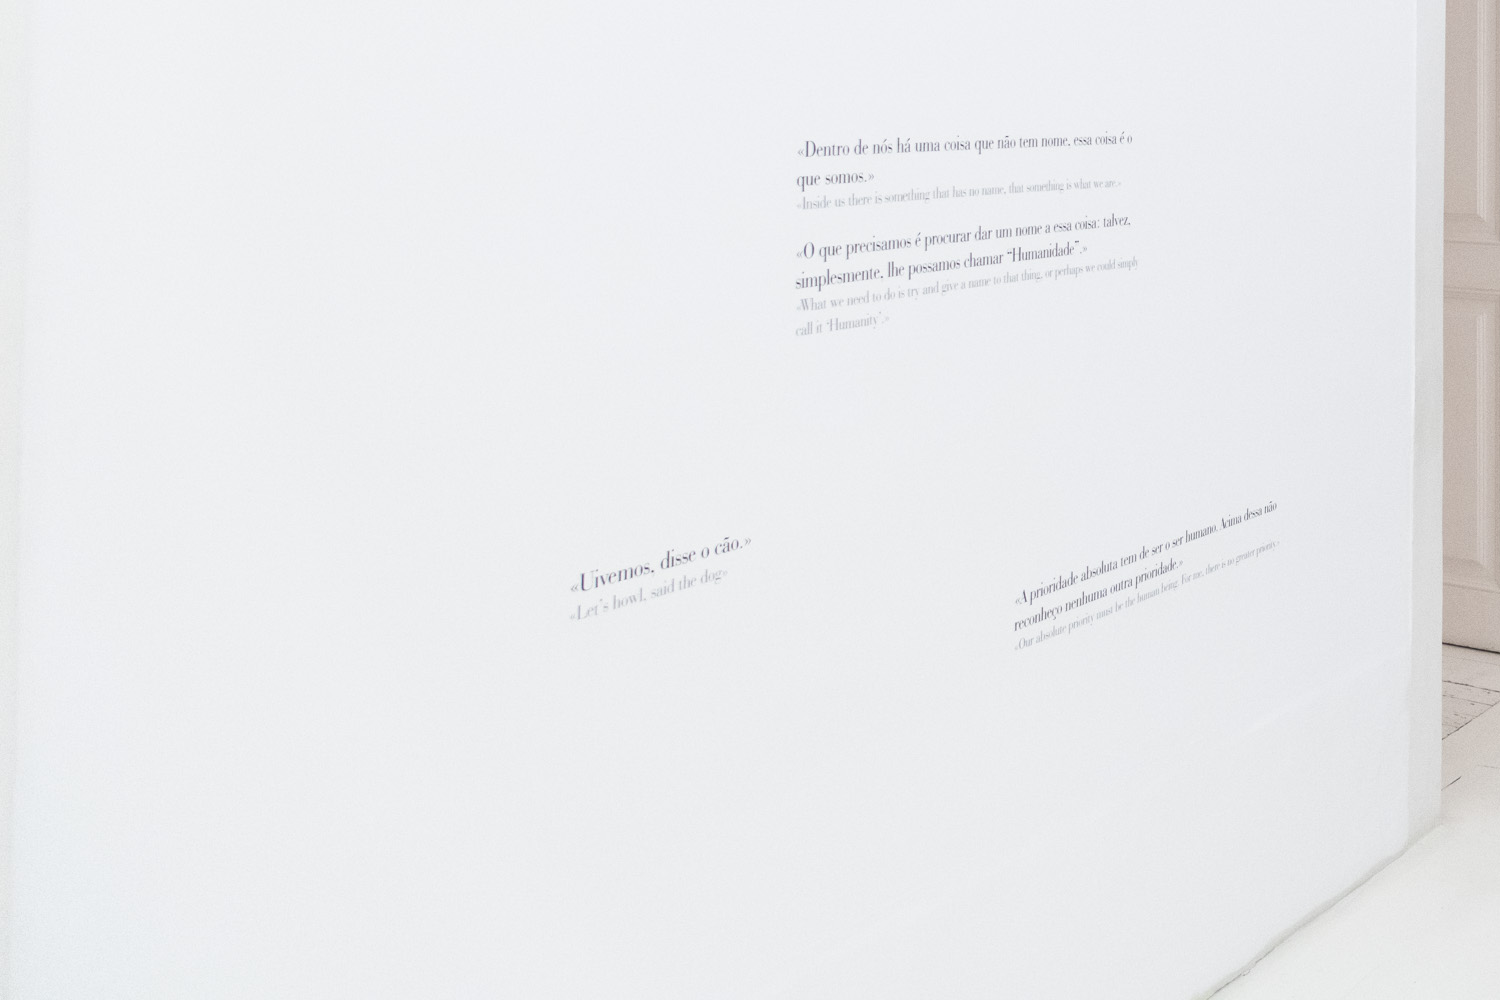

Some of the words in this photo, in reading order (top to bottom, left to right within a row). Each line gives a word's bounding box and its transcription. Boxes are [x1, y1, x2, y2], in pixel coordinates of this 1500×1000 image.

[798, 140, 850, 158] «Dentro
[853, 139, 869, 155] de
[873, 138, 893, 154] nós
[897, 137, 911, 153] há
[915, 142, 940, 152] uma
[944, 136, 971, 151] coisa
[974, 140, 994, 155] que
[997, 135, 1016, 149] não
[1019, 137, 1038, 148] tem
[1073, 137, 1092, 145] essa
[1095, 131, 1117, 145] coisa
[1119, 131, 1125, 144] é
[796, 175, 821, 192] que
[825, 173, 874, 184] somos.»
[797, 242, 815, 259] «O
[818, 245, 842, 263] que
[846, 236, 911, 260] precisamos
[914, 232, 921, 247] é
[924, 232, 971, 251] procurar
[974, 226, 992, 241] dar
[995, 228, 1012, 239] um
[1015, 225, 1042, 237] nome
[1045, 224, 1050, 233] a
[1053, 222, 1072, 232] essa
[1074, 216, 1099, 231] coisa:
[888, 261, 905, 278] lhe
[908, 260, 960, 280] possamos
[963, 253, 1004, 268] chamar
[660, 549, 696, 570] disse
[701, 547, 710, 558] o
[714, 536, 751, 555] cão.»
[1015, 589, 1027, 605] «A
[1030, 571, 1078, 605] prioridade
[1080, 560, 1118, 582] absoluta
[1120, 554, 1137, 567] tem
[1139, 545, 1149, 560] de
[1152, 544, 1163, 555] ser
[1165, 542, 1170, 550] o
[1172, 537, 1183, 548] ser
[1185, 525, 1217, 543] humano.
[1221, 515, 1242, 529] Acima
[1244, 508, 1262, 521] dessa
[1264, 501, 1277, 514] não
[651, 578, 675, 599] said
[678, 575, 697, 591] the
[1014, 606, 1063, 631] reconheço
[1065, 588, 1107, 612] nenhuma
[1110, 579, 1133, 594] outra
[1135, 558, 1183, 589] prioridade.»
